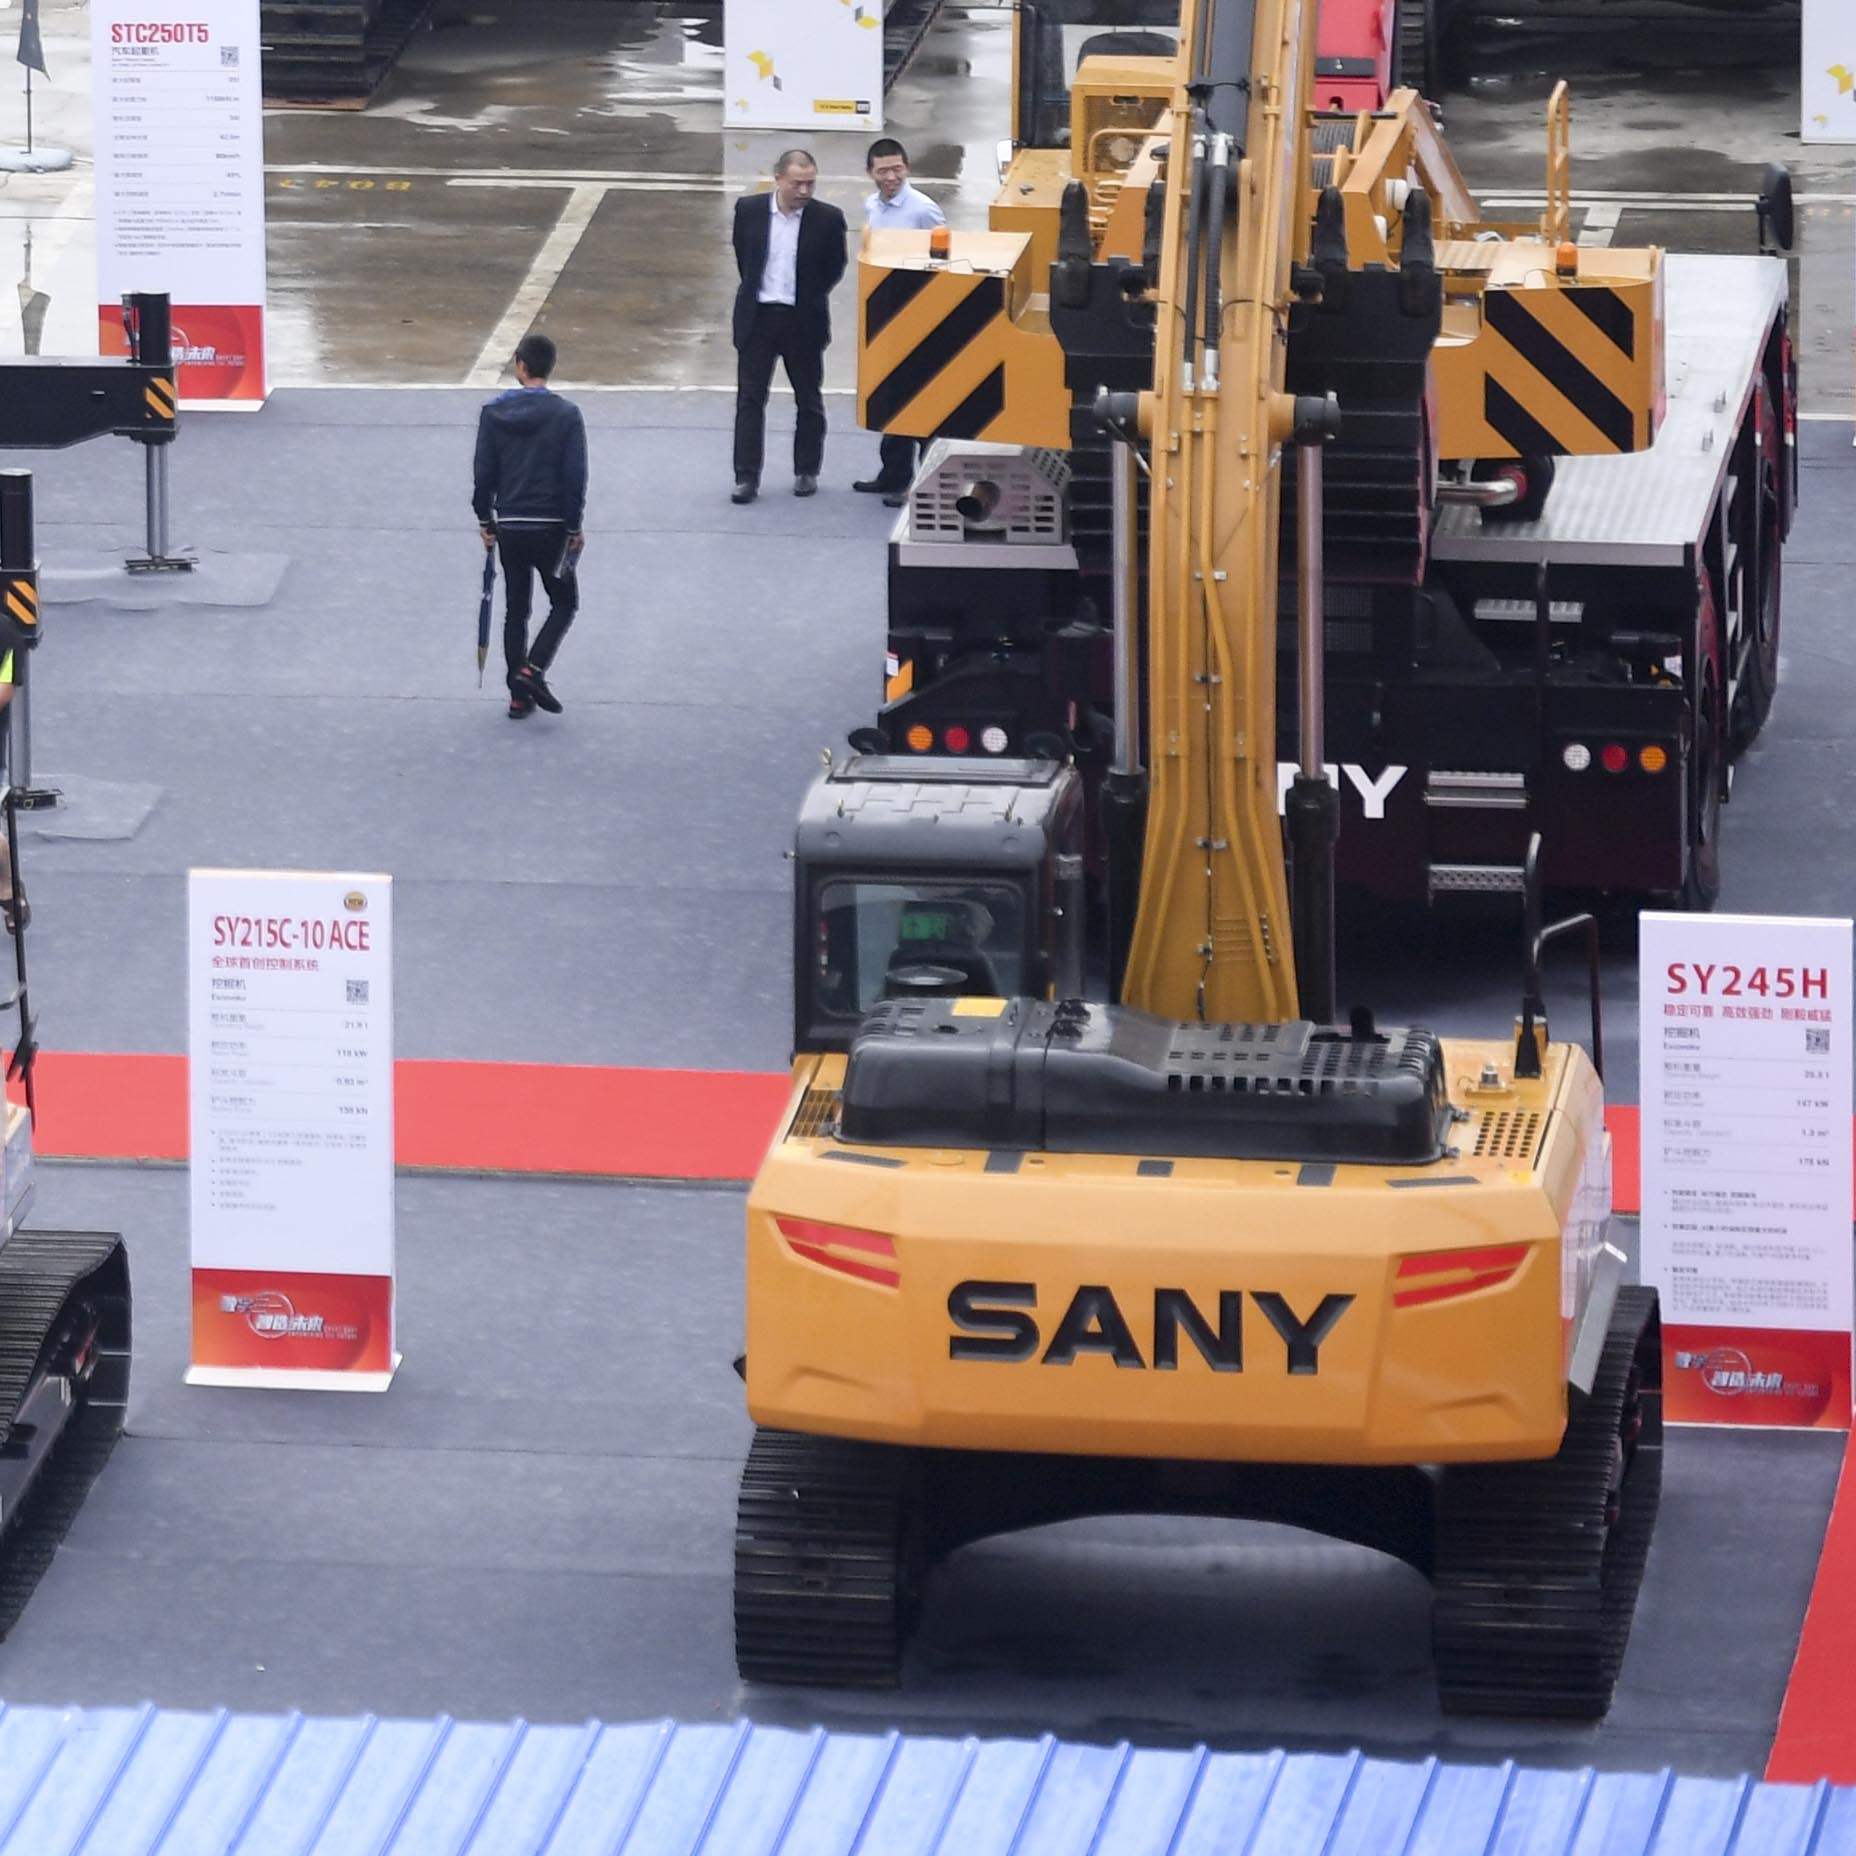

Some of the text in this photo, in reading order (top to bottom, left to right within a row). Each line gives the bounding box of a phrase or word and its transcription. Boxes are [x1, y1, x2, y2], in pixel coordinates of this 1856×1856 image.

[111, 23, 209, 43] STC250T5
[214, 915, 370, 952] SY215C-10 ACE
[1667, 963, 1828, 999] SY245H
[947, 1280, 1357, 1376] SANY
